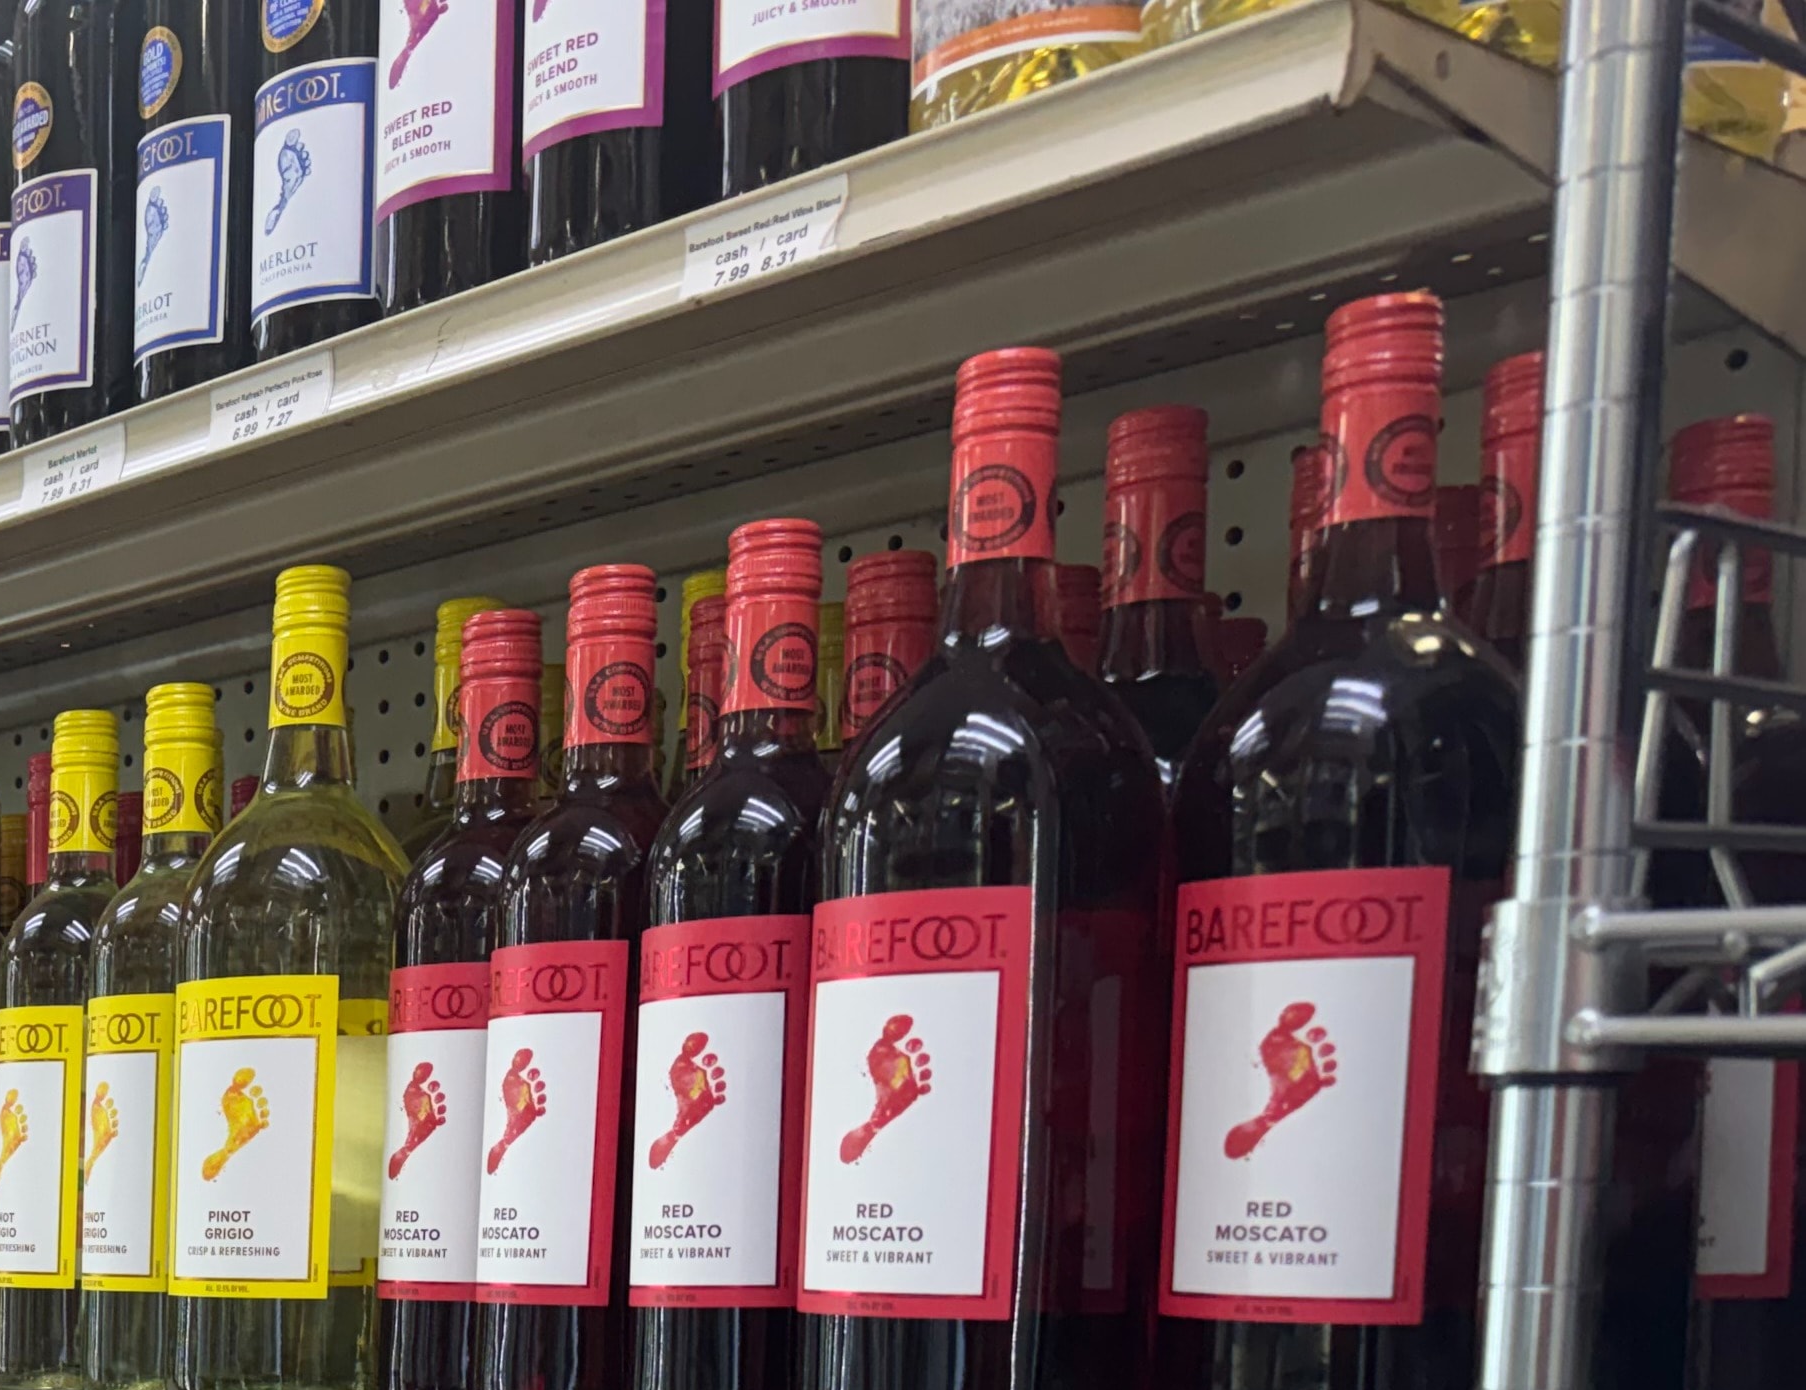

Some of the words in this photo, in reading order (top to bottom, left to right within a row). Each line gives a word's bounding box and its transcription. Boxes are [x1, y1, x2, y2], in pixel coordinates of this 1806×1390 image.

[527, 43, 561, 75] SWEET
[566, 33, 598, 53] RED
[535, 59, 578, 87] BLEND
[554, 74, 597, 96] SMOOTH
[384, 110, 417, 139] SWEET
[422, 101, 452, 119] RED
[393, 125, 433, 151] BLEND
[410, 141, 451, 159] SMOOTH
[689, 235, 724, 252] Barefoot
[716, 245, 748, 265] cash
[777, 224, 808, 246] card
[259, 242, 318, 274] MERLOT
[714, 264, 749, 286] 7.99
[761, 248, 796, 271] 8.31
[235, 405, 257, 422] cash
[277, 390, 299, 408] card
[233, 422, 258, 440] 6.99
[266, 410, 292, 429] 7.27
[44, 472, 63, 487] cash
[80, 460, 99, 474] card
[42, 487, 63, 502] 7.99
[69, 478, 91, 494] 8.31
[292, 674, 313, 683] MOST
[285, 686, 320, 696] AWARDED
[1186, 897, 1425, 955] BAREFOOT
[817, 914, 1006, 969] BAREFOOT
[180, 994, 321, 1033] BAREFOOT
[208, 1211, 251, 1222] PINOT
[396, 1211, 419, 1223] RED
[494, 1207, 517, 1221] RED
[661, 1204, 694, 1218] RED
[856, 1204, 894, 1218] RED
[1246, 1201, 1292, 1218] RED
[205, 1227, 254, 1240] GRIGIO
[384, 1228, 440, 1241] MOSCATO
[482, 1227, 540, 1240] MOSCATO
[644, 1224, 721, 1239] MOSCATO
[833, 1226, 923, 1242] MOSCATO
[1215, 1224, 1327, 1243] MOSCATO
[188, 1246, 208, 1256] CRISP
[211, 1246, 216, 1256] &
[219, 1246, 280, 1257] REFRESHING
[406, 1248, 447, 1259] VIBRANT
[504, 1248, 547, 1259] VIBRANT
[640, 1247, 664, 1259] SWEET
[667, 1247, 675, 1258] &
[678, 1247, 731, 1259] VIBRANT
[826, 1250, 858, 1263] SWEET
[862, 1251, 870, 1263] &
[874, 1250, 933, 1264] VIBRANT
[1206, 1249, 1249, 1265] SWEET
[1254, 1250, 1263, 1265] &
[1269, 1251, 1338, 1266] VIBRANT
